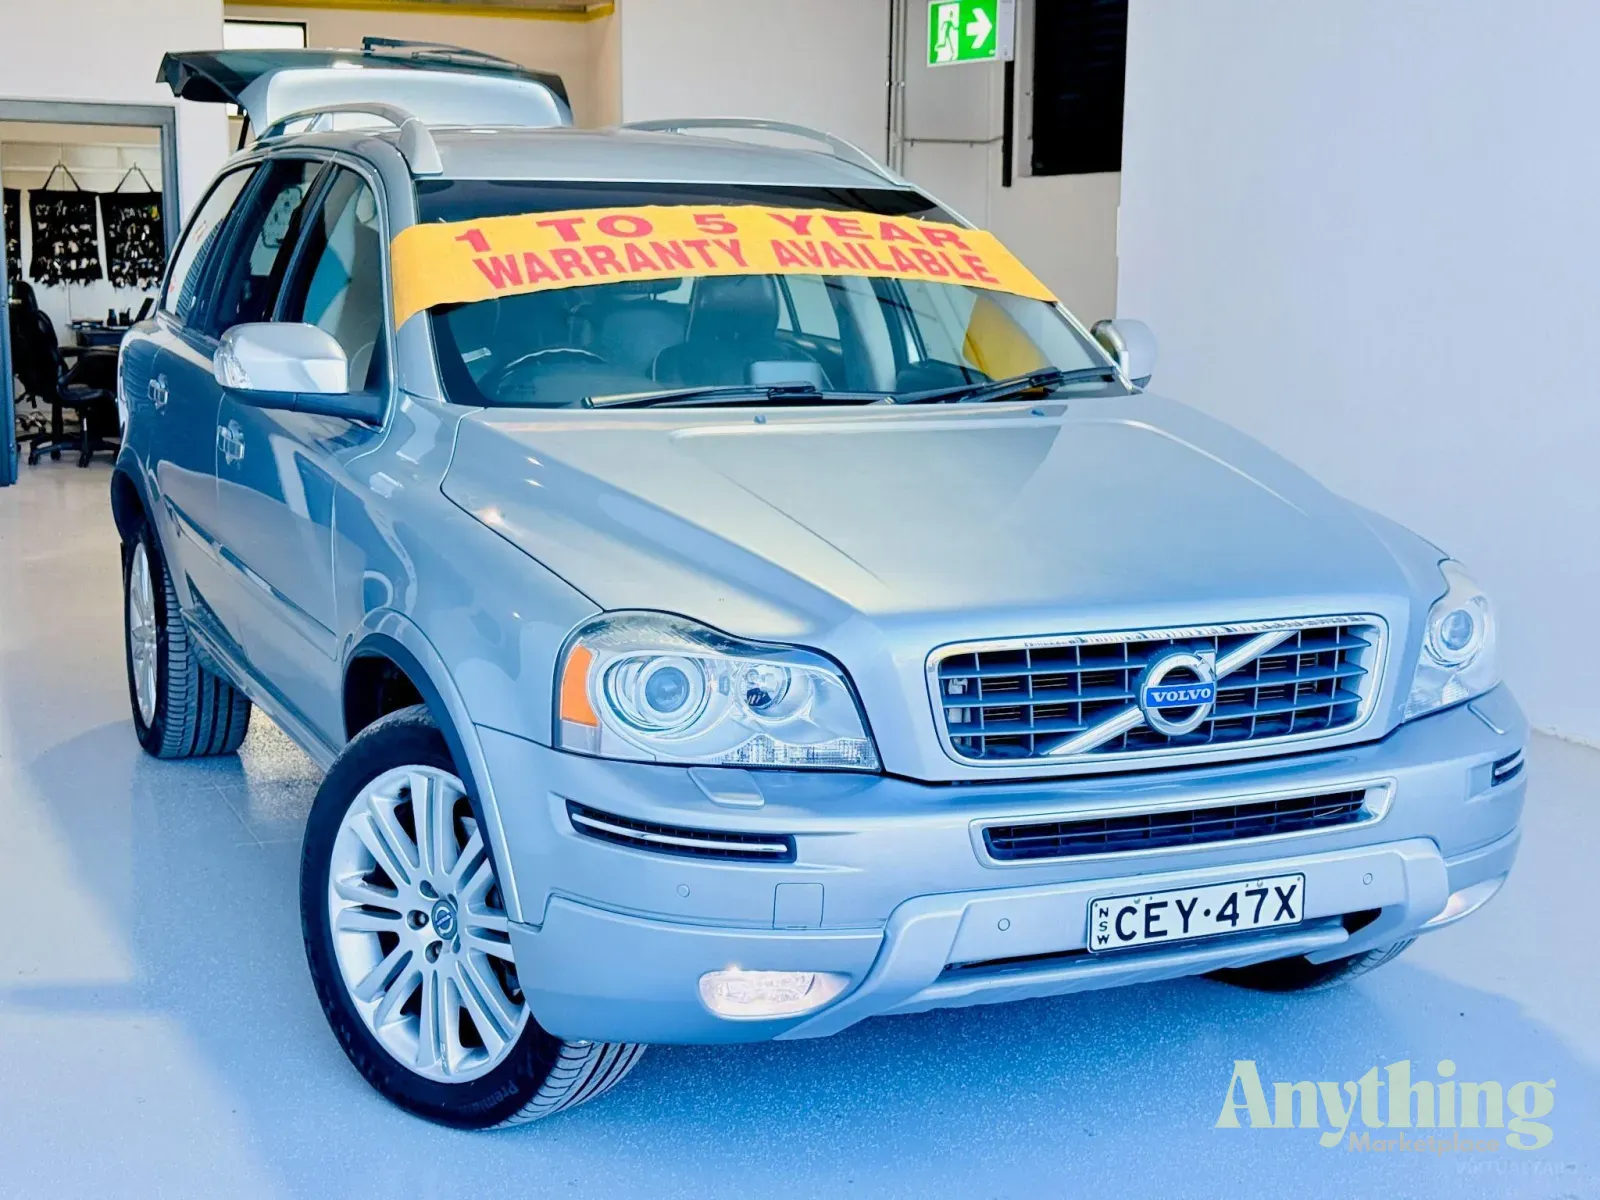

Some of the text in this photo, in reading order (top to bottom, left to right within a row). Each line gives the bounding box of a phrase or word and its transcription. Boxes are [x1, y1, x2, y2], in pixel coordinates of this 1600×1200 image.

[455, 213, 972, 252] 1 TO 5 YEAR
[472, 239, 1000, 289] WARRANTY AVAILABLE
[1151, 688, 1211, 703] VOLVO
[1097, 906, 1109, 946] NSW
